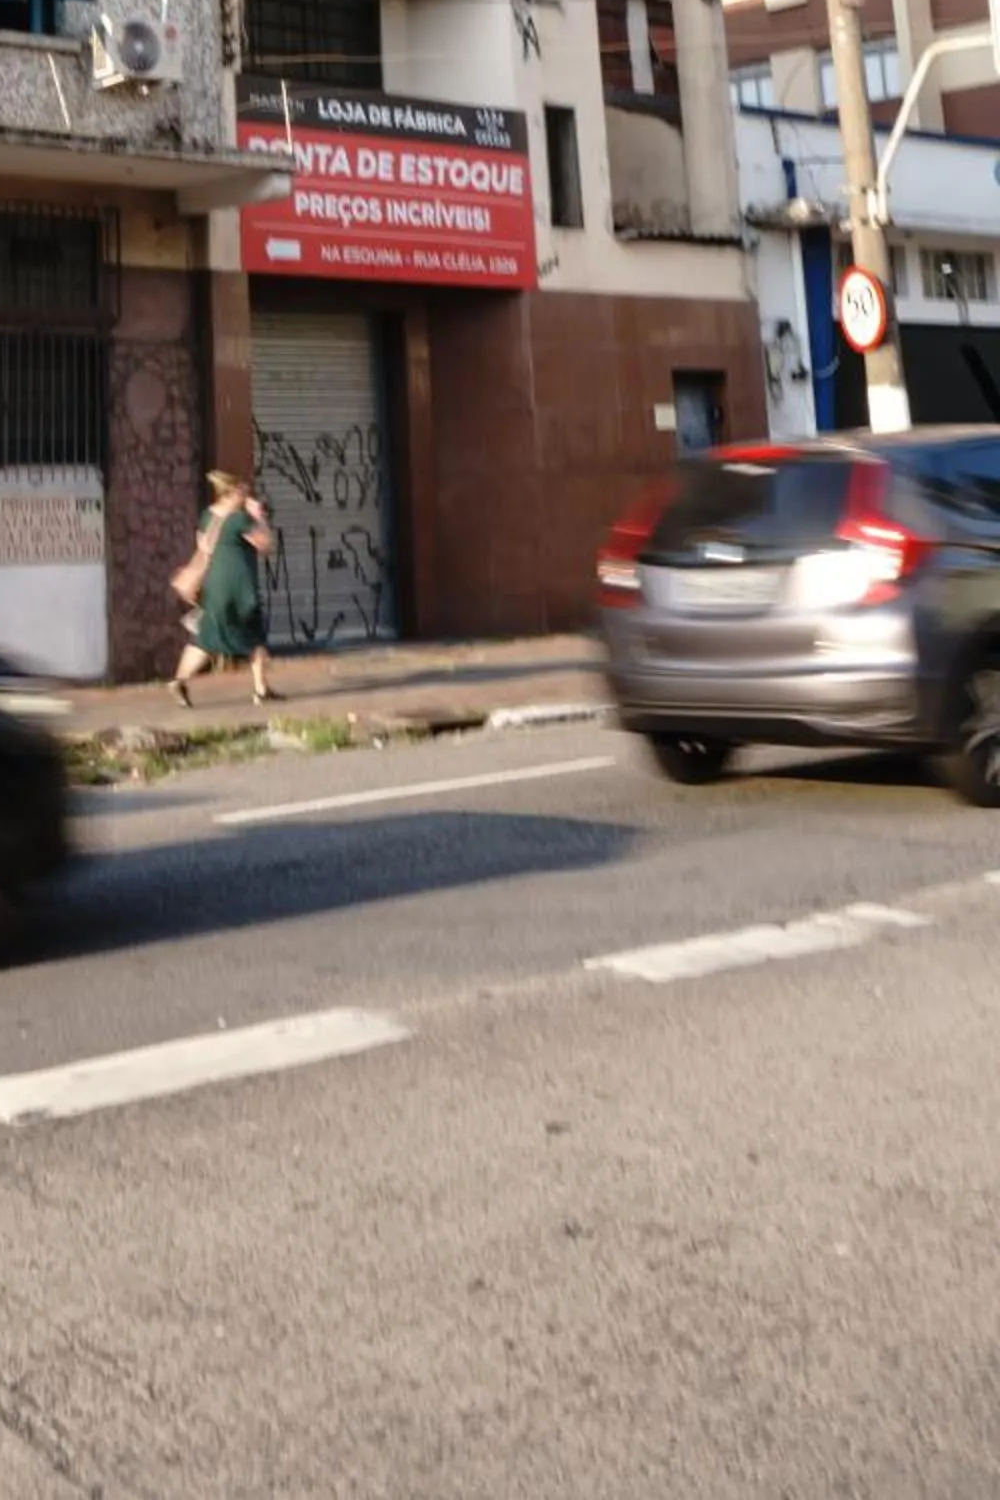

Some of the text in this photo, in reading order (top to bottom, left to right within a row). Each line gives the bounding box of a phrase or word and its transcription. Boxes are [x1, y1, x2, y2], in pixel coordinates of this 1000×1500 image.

[317, 97, 367, 124] LOJA
[368, 104, 393, 128] DE
[393, 104, 467, 136] FÁBRICA
[357, 147, 394, 181] DE
[401, 152, 523, 196] ESTOQUE
[295, 190, 491, 233] PREÇOS INCRÍVEIS!
[321, 244, 342, 263] NA
[413, 249, 440, 269] RUA
